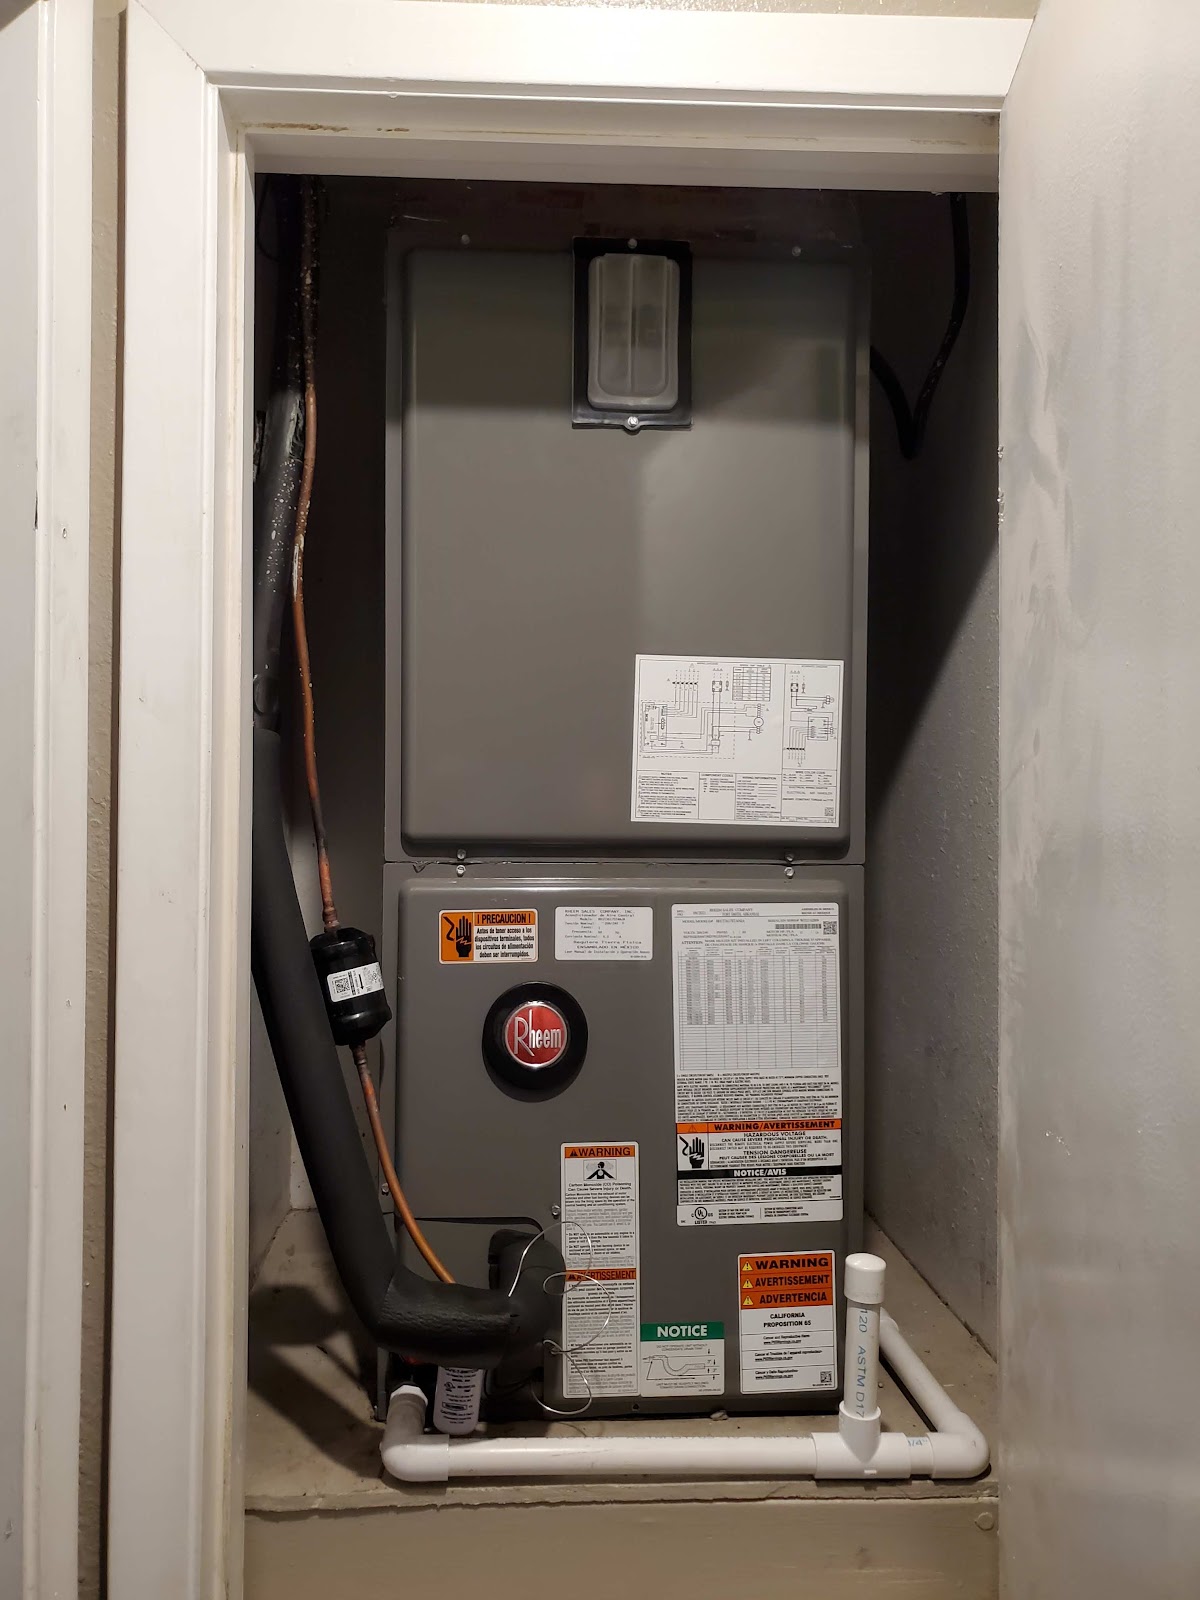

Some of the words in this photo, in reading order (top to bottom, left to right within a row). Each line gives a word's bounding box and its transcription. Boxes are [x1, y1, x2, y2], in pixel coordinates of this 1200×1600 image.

[482, 913, 526, 924] PRECAUCION
[514, 1009, 561, 1056] Rheem
[714, 1121, 835, 1130] WARNING/AVERTISSEMENT
[579, 1147, 631, 1156] WARNING
[755, 1257, 829, 1269] WARNING
[576, 1271, 635, 1280] AERTISSEMENT
[755, 1275, 830, 1287] AVERTISSEMENT
[760, 1292, 827, 1304] ADVERTENCIA
[858, 1309, 868, 1333] 120
[657, 1325, 707, 1337] NOTICE
[857, 1346, 866, 1387] ASTM
